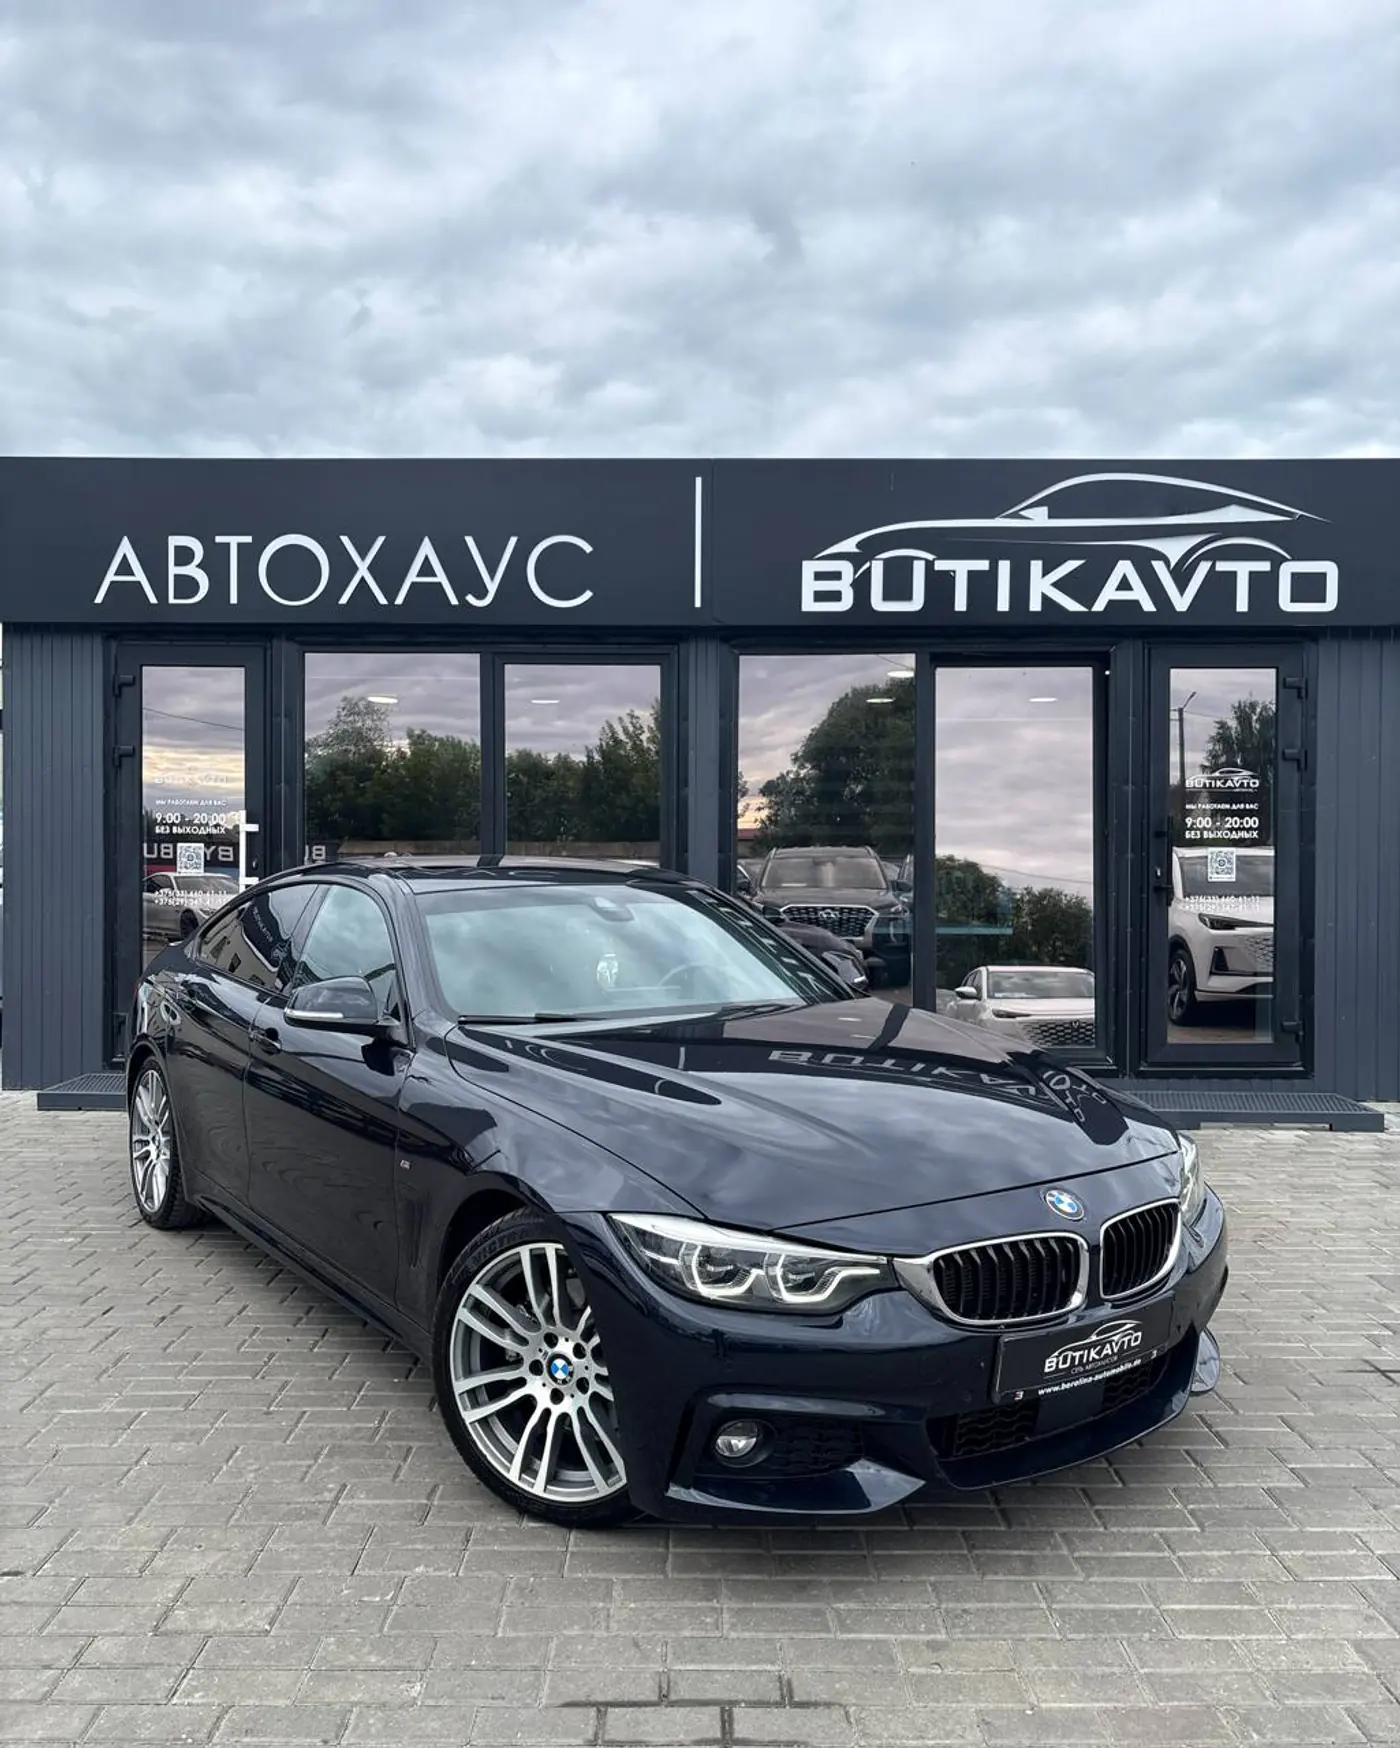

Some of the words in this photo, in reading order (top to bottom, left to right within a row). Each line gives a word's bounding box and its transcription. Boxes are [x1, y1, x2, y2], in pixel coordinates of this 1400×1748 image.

[94, 534, 594, 608] АВТОХАУС
[801, 559, 1339, 612] BUTIKAVTO
[1185, 778, 1260, 788] BUTIKAVTO
[155, 812, 181, 824] 9:00
[193, 812, 227, 824] 20:00
[1185, 816, 1212, 828] 9:00
[1224, 816, 1259, 828] 20:00
[155, 826, 171, 834] БЕЗ
[172, 826, 227, 835] ВЫХОДНЫХ
[1185, 830, 1201, 839] БЕЗ
[1203, 830, 1259, 840] ВЫХОДНЫХ
[1043, 1331, 1143, 1373] BUTIKAVTO
